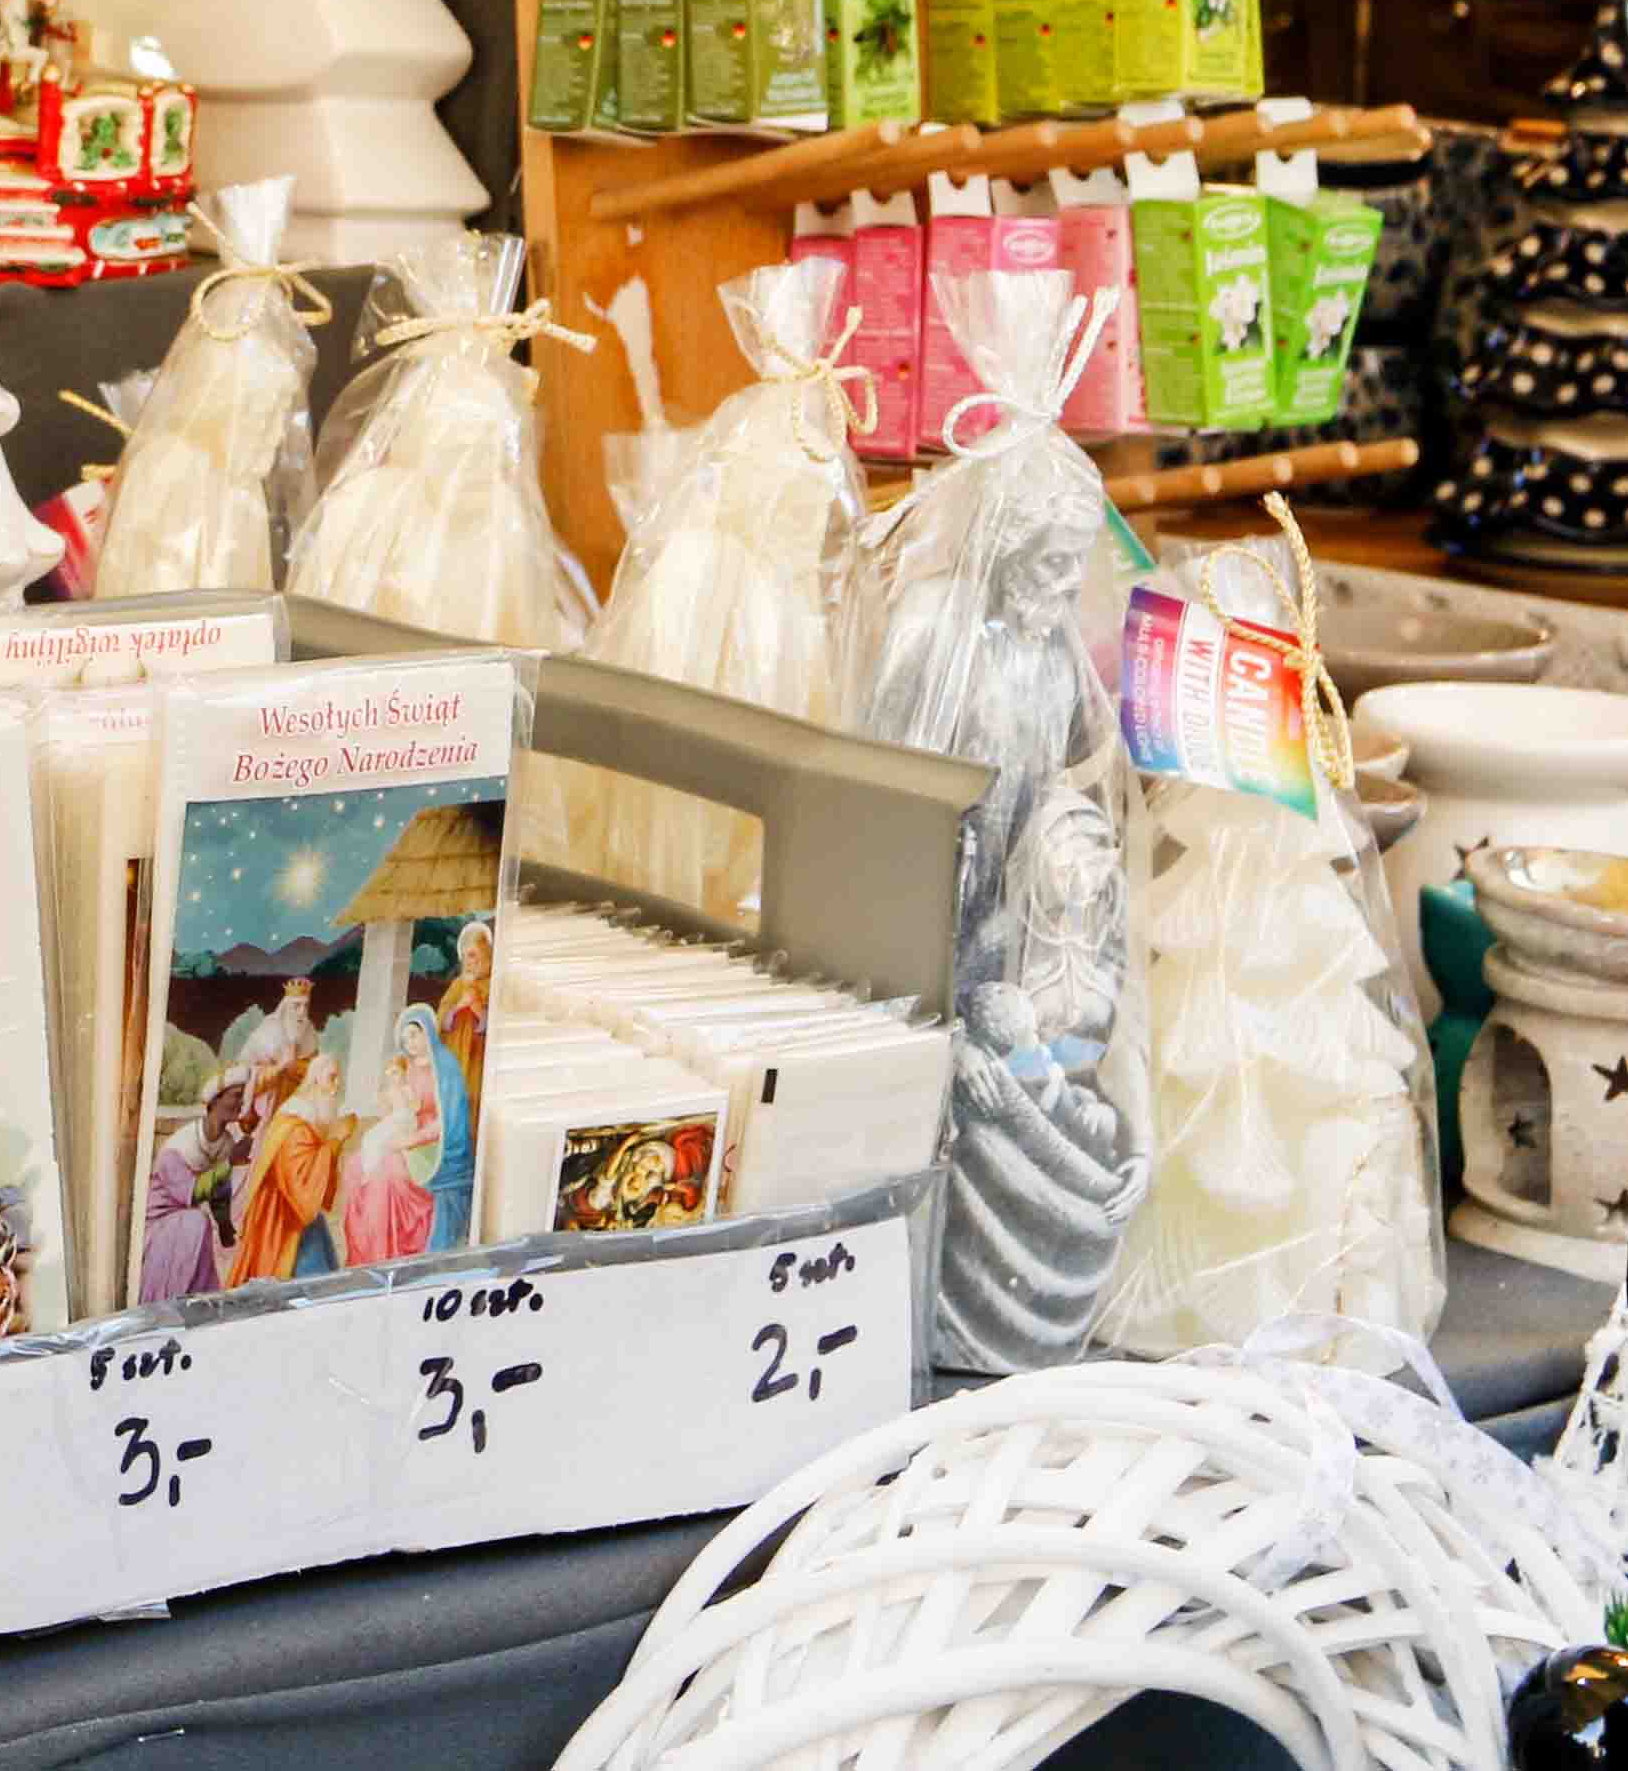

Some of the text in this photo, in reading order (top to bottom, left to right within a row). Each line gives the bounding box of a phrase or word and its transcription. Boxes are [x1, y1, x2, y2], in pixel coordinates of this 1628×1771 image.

[258, 685, 462, 738] Wesołych Świąt
[232, 737, 479, 789] Bożego Narodzenia
[768, 1251, 796, 1293] 5
[422, 1288, 463, 1322] 10
[89, 1345, 115, 1390] 5
